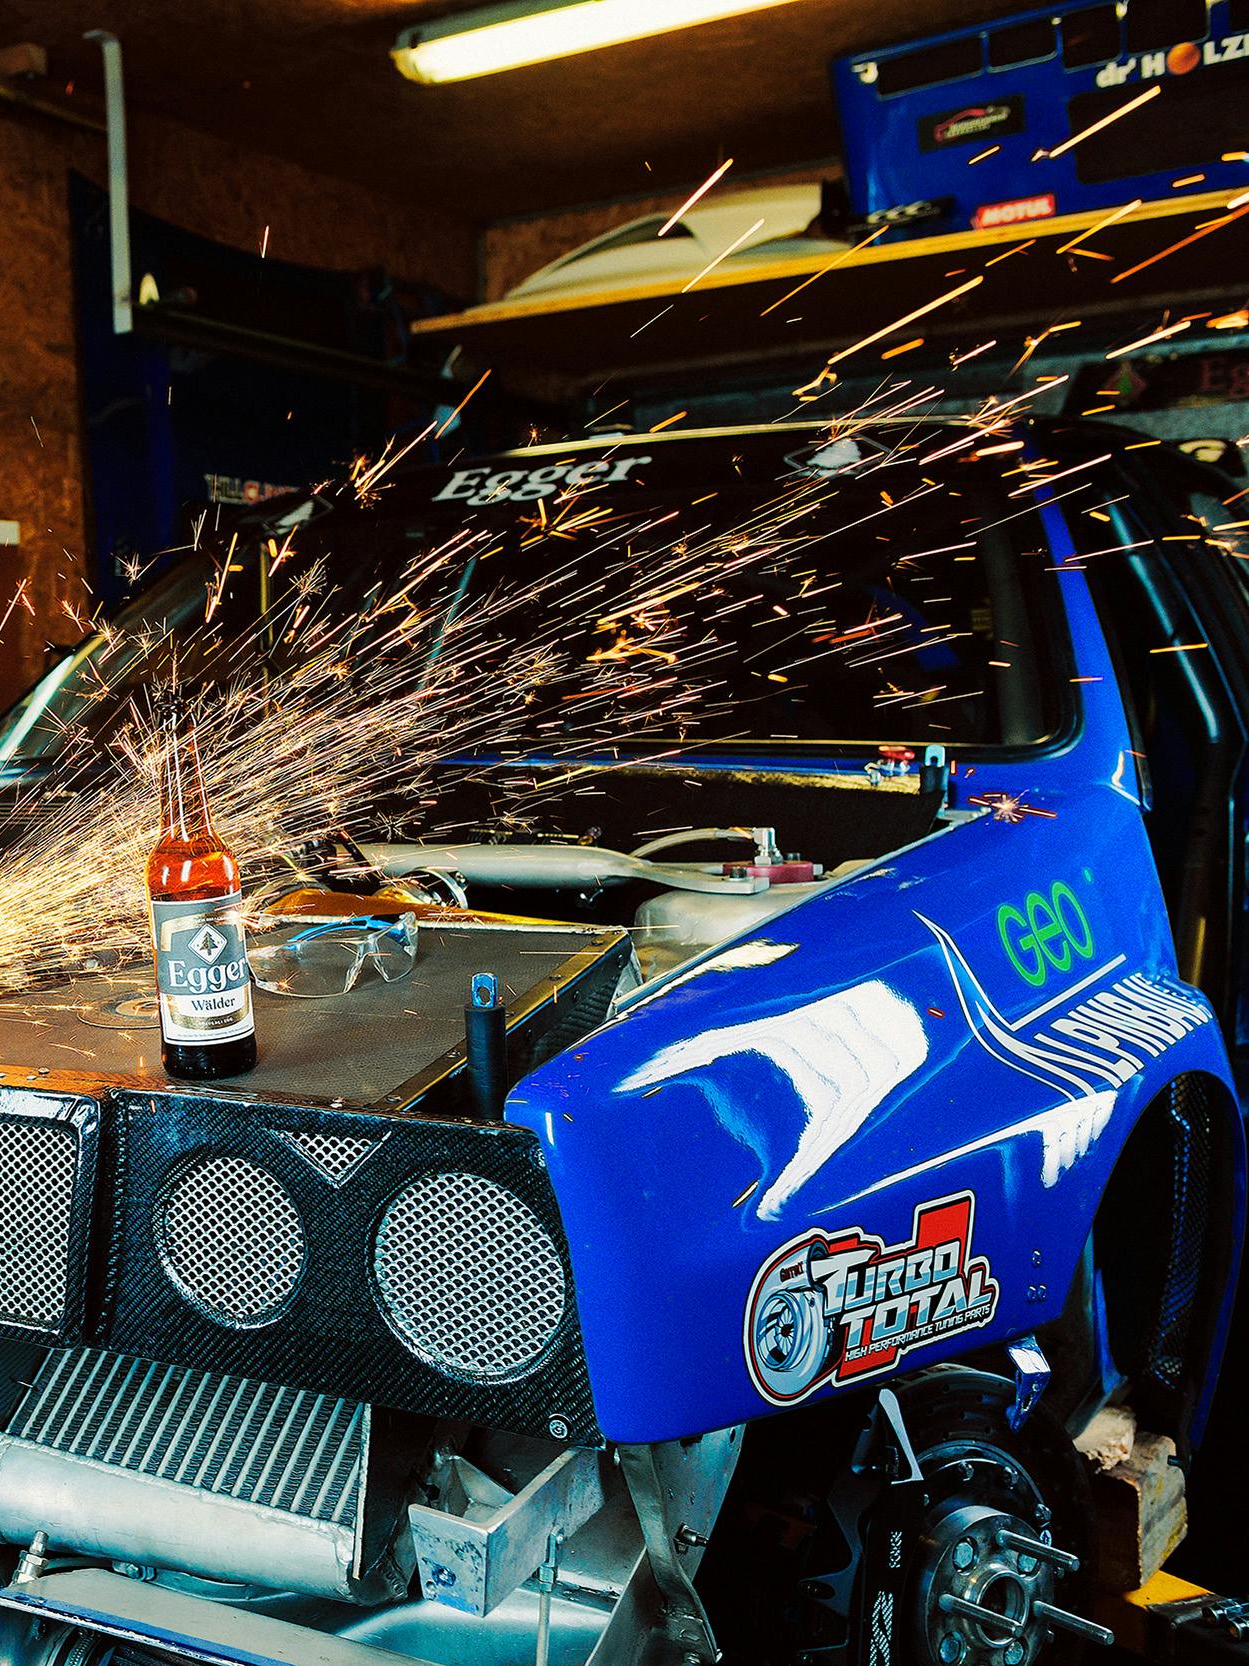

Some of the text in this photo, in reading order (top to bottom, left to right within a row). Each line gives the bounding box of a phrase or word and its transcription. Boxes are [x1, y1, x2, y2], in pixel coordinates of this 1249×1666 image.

[1141, 32, 1249, 79] HOLZ
[431, 456, 653, 507] Egger
[167, 957, 247, 994] Egger
[191, 996, 236, 1011] Wälder
[810, 1240, 961, 1317] TURBO
[839, 1269, 992, 1350] TOTAL
[845, 1303, 991, 1362] HIGH PERFORMANCE TUNING PARTS
